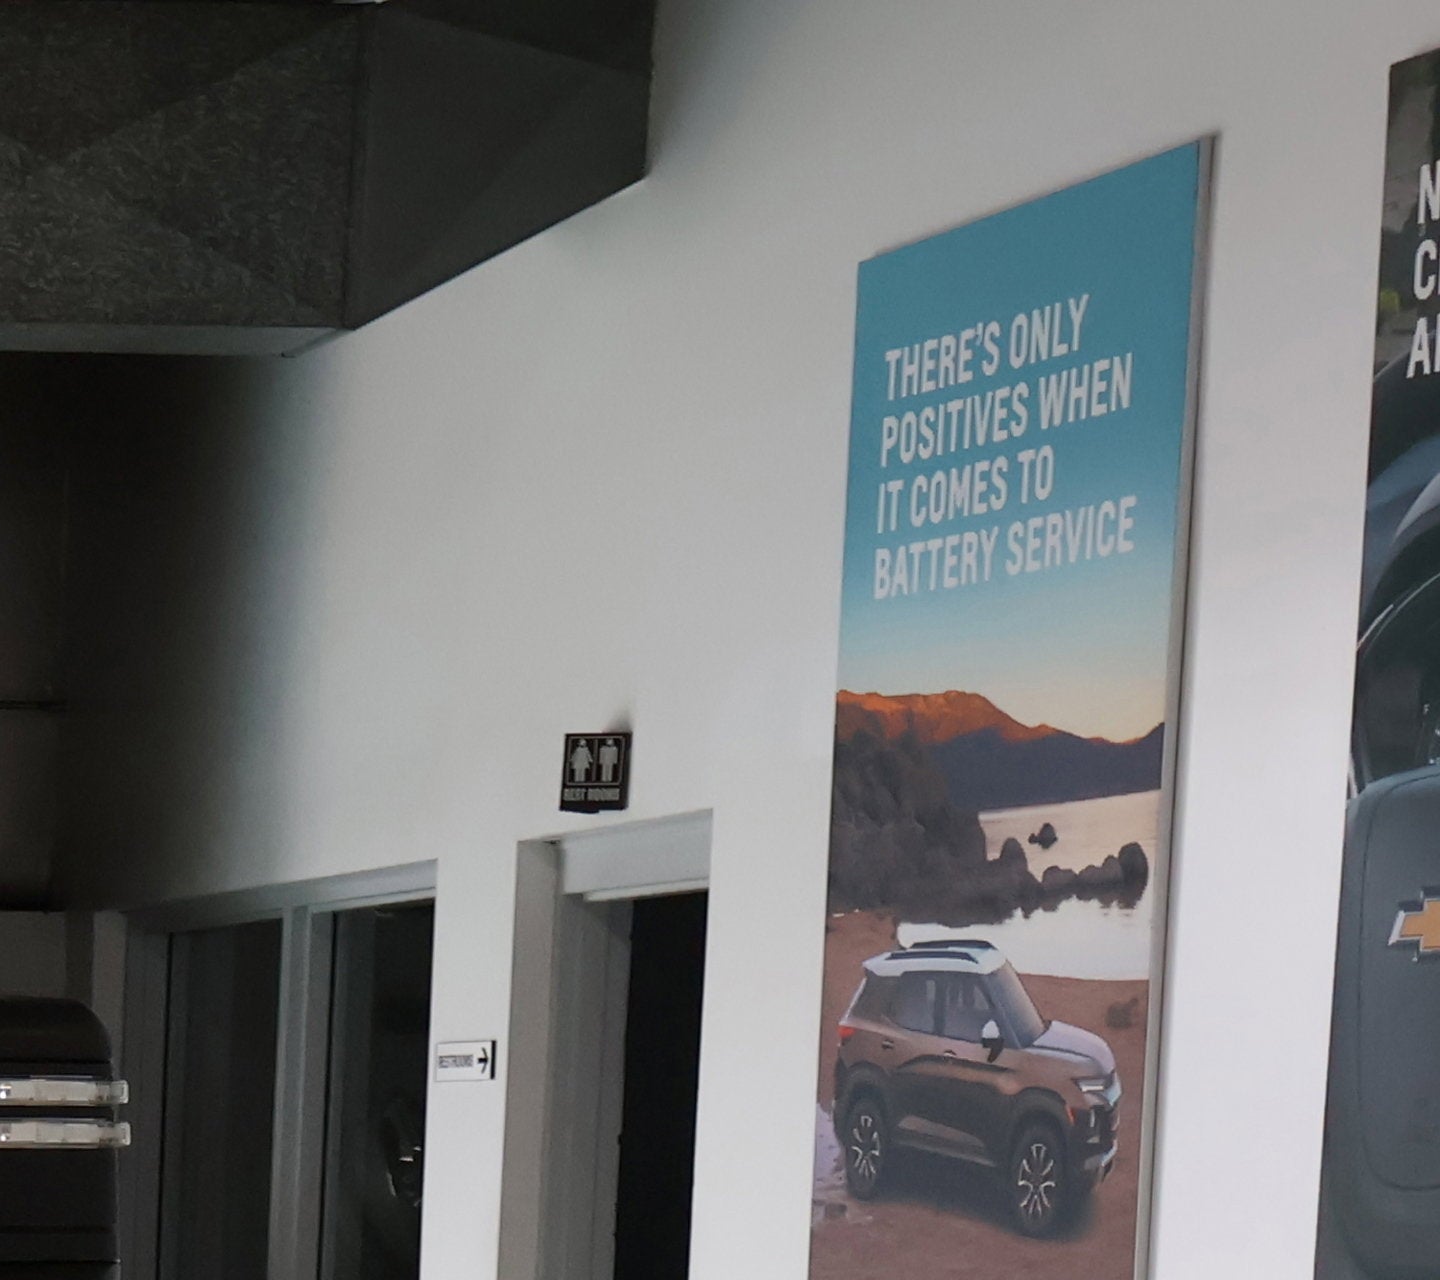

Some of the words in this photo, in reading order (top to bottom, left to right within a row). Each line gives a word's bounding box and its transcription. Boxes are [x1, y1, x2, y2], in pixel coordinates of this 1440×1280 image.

[1414, 239, 1440, 300] C
[885, 320, 1001, 400] THERE'S
[1009, 294, 1089, 369] ONLY
[881, 382, 1029, 468] POSITIVES
[1039, 352, 1133, 430] WHEN
[877, 479, 905, 534] IT
[910, 456, 1008, 528] COMES
[1017, 445, 1054, 504] TO
[874, 526, 999, 599] BATTERY
[1005, 495, 1137, 575] SERVICE
